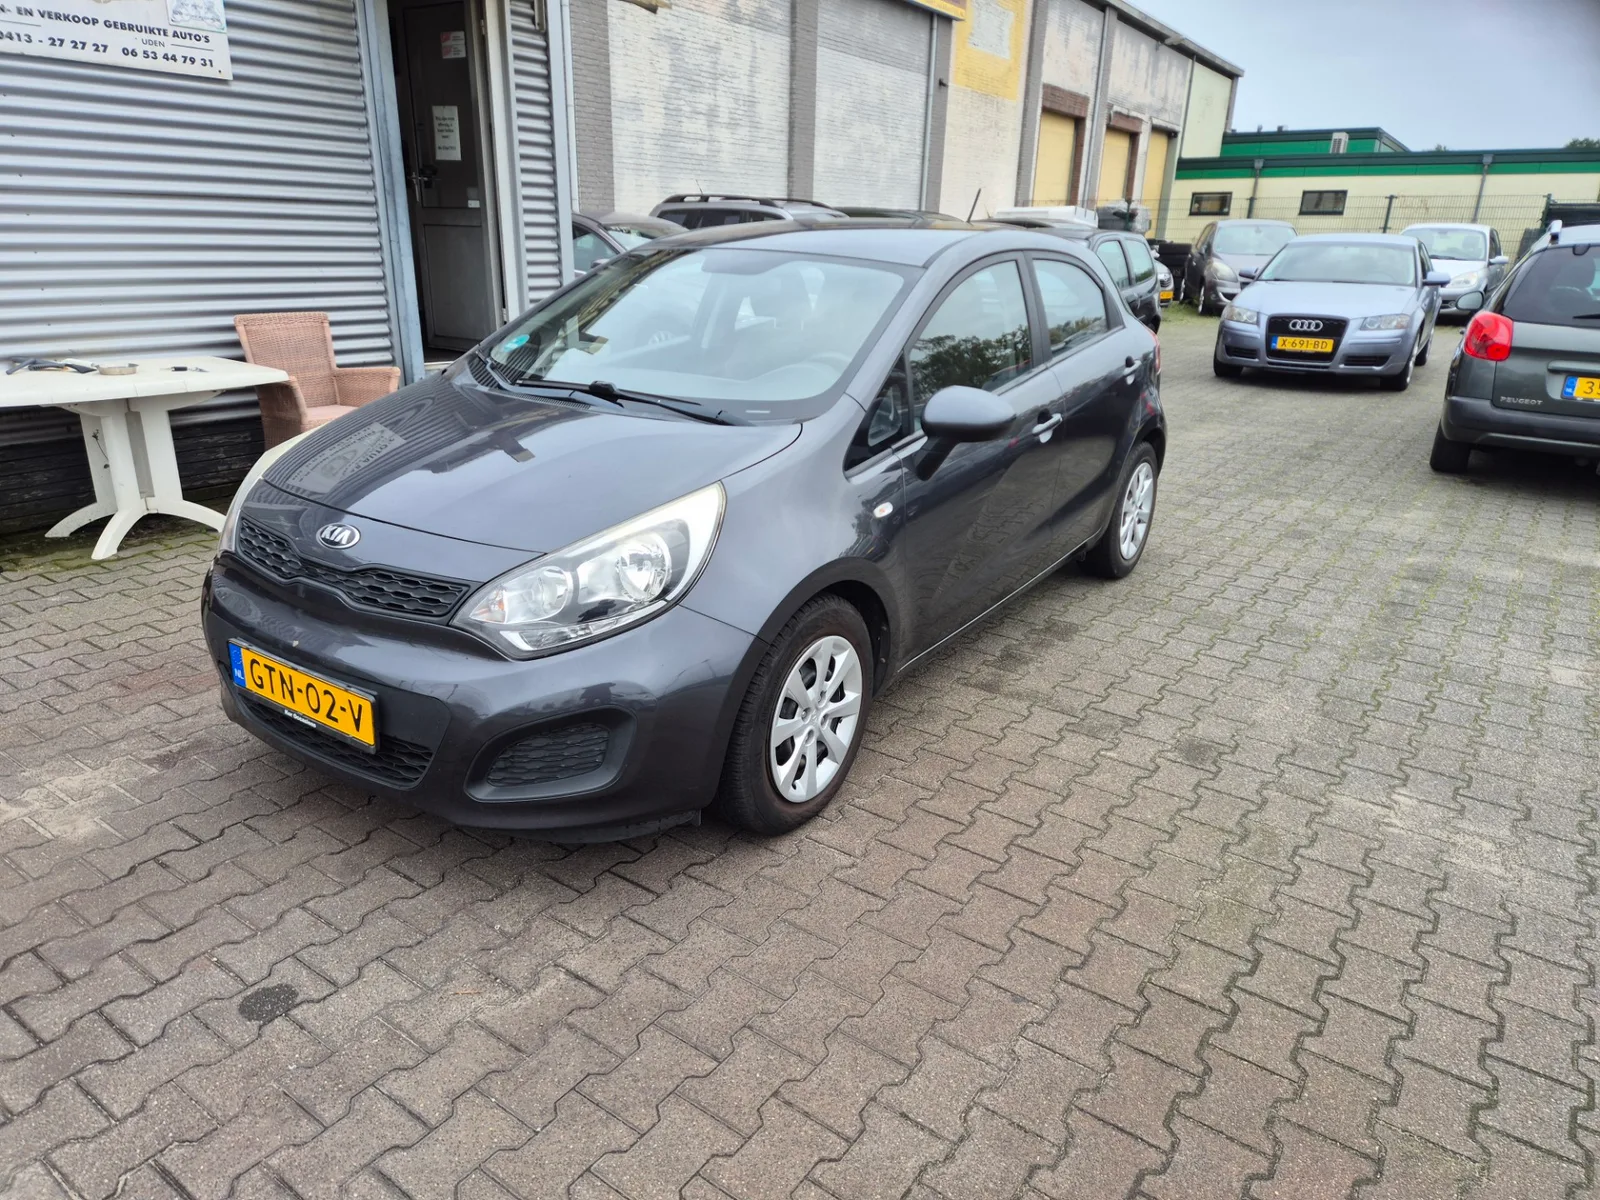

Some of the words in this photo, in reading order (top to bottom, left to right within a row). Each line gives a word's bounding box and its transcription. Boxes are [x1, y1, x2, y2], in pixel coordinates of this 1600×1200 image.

[16, 6, 34, 17] EN
[37, 9, 99, 25] VERKOOP
[104, 20, 168, 36] GEBRUIKTE
[172, 30, 210, 43] AUTO'S
[48, 37, 65, 47] 27
[70, 40, 87, 50] 27
[92, 43, 108, 53] 27
[122, 47, 138, 57] 06
[143, 50, 158, 60] 53
[162, 53, 178, 63] 44
[181, 55, 196, 65] 79
[200, 58, 213, 67] 31
[142, 38, 165, 47] UDEN
[1281, 339, 1328, 350] X-691-BD
[1500, 396, 1543, 405] PEUGEOT
[321, 525, 351, 544] KIA
[234, 668, 244, 679] NL
[250, 658, 362, 732] GTN-02-V
